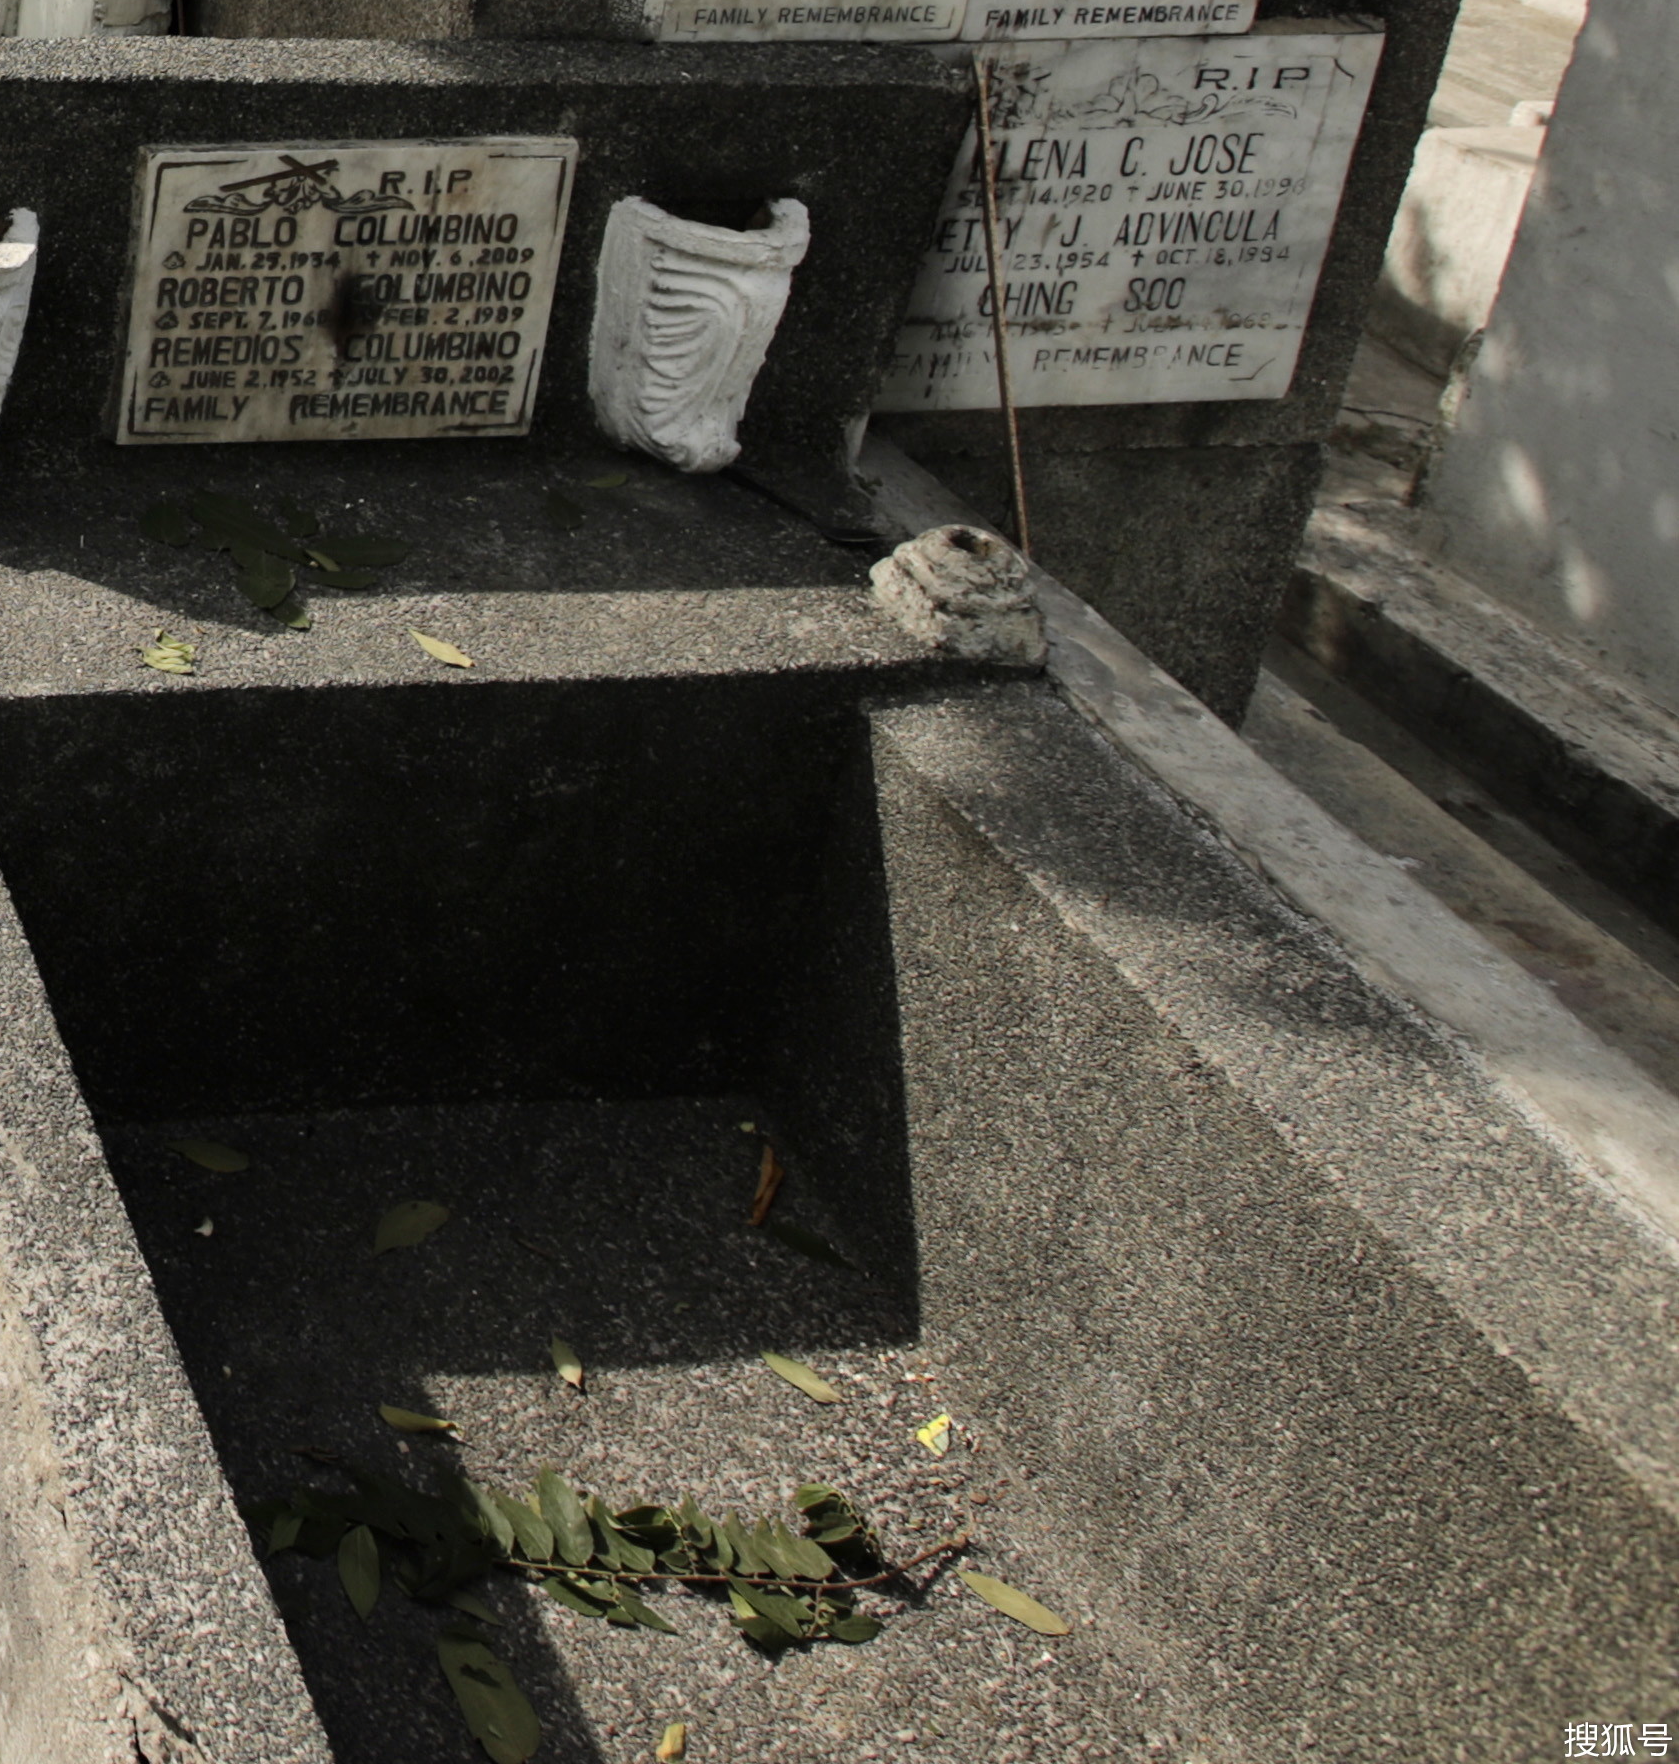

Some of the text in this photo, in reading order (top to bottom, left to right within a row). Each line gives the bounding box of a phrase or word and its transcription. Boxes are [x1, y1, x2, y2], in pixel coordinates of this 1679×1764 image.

[694, 5, 937, 26] FAMILY REMEMBRANCE
[985, 3, 1239, 28] FAMILY REMEMBRANCE
[1169, 133, 1265, 177] JOSE
[1146, 181, 1207, 201] JUNE
[186, 213, 518, 249] PABLO COLUMBINO
[1113, 209, 1280, 247] ADVINCULA
[195, 251, 246, 272] JAN.
[390, 248, 441, 268] NOV.
[944, 254, 1000, 274] JUL
[157, 275, 304, 309] ROBERTO
[978, 277, 1187, 317] CHING SOO
[188, 311, 248, 330] SEPT.
[149, 331, 521, 368] REMEDIOS COLUMBINO
[180, 370, 236, 390] JUNE
[347, 366, 409, 387] JULY
[143, 390, 510, 425] FAMILY REMEMBRANCE
